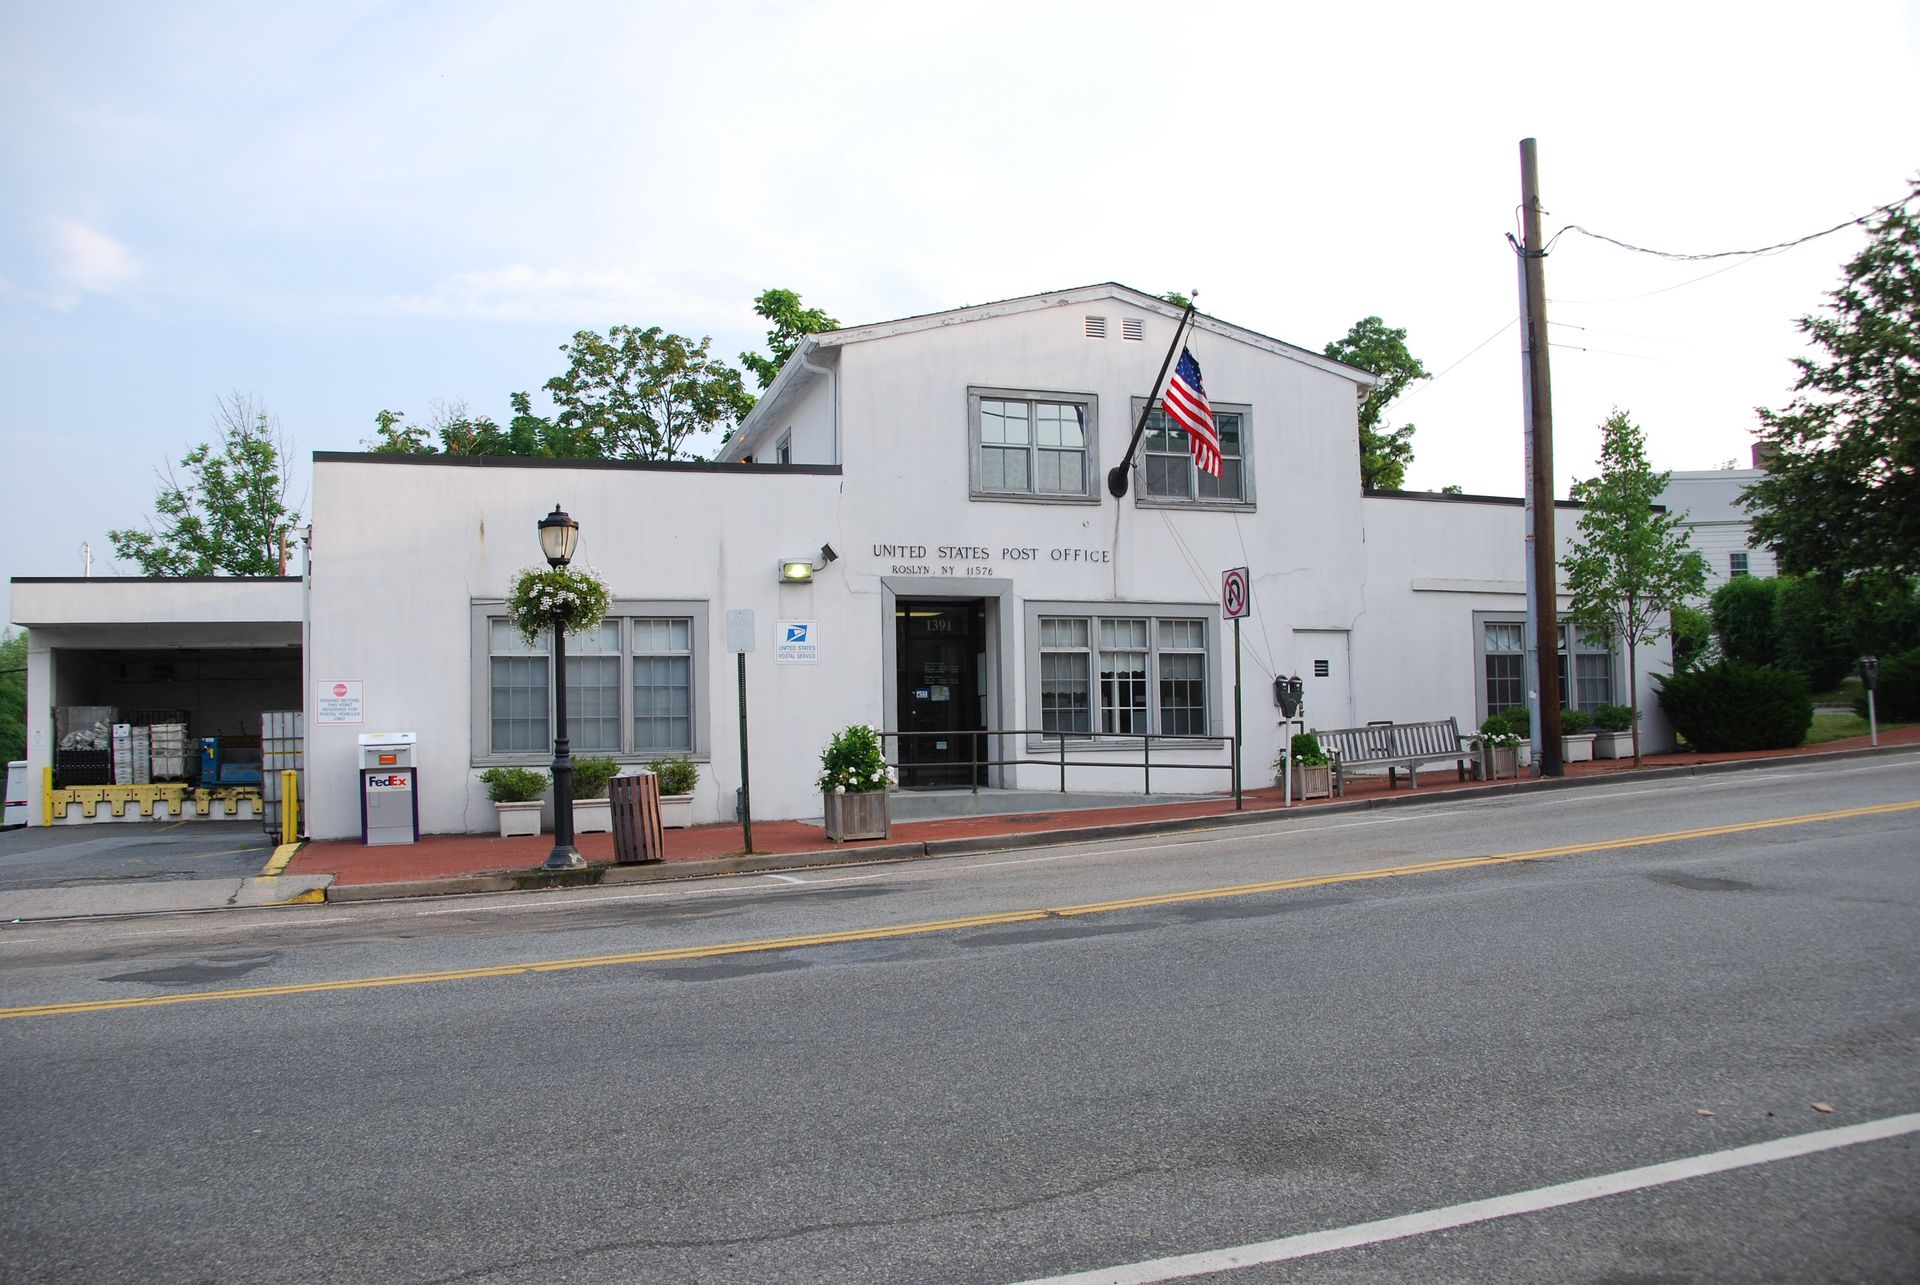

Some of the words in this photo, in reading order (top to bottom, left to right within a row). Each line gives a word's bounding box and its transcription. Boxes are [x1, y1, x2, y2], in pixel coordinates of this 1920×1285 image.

[873, 544, 927, 558] UNITED
[938, 545, 990, 560] STATES
[1002, 547, 1040, 560] POST
[1050, 548, 1110, 563] OFFICE
[941, 565, 955, 575] NY
[966, 566, 993, 576] 11576
[926, 619, 951, 632] 1391
[369, 775, 406, 787] FedEx
